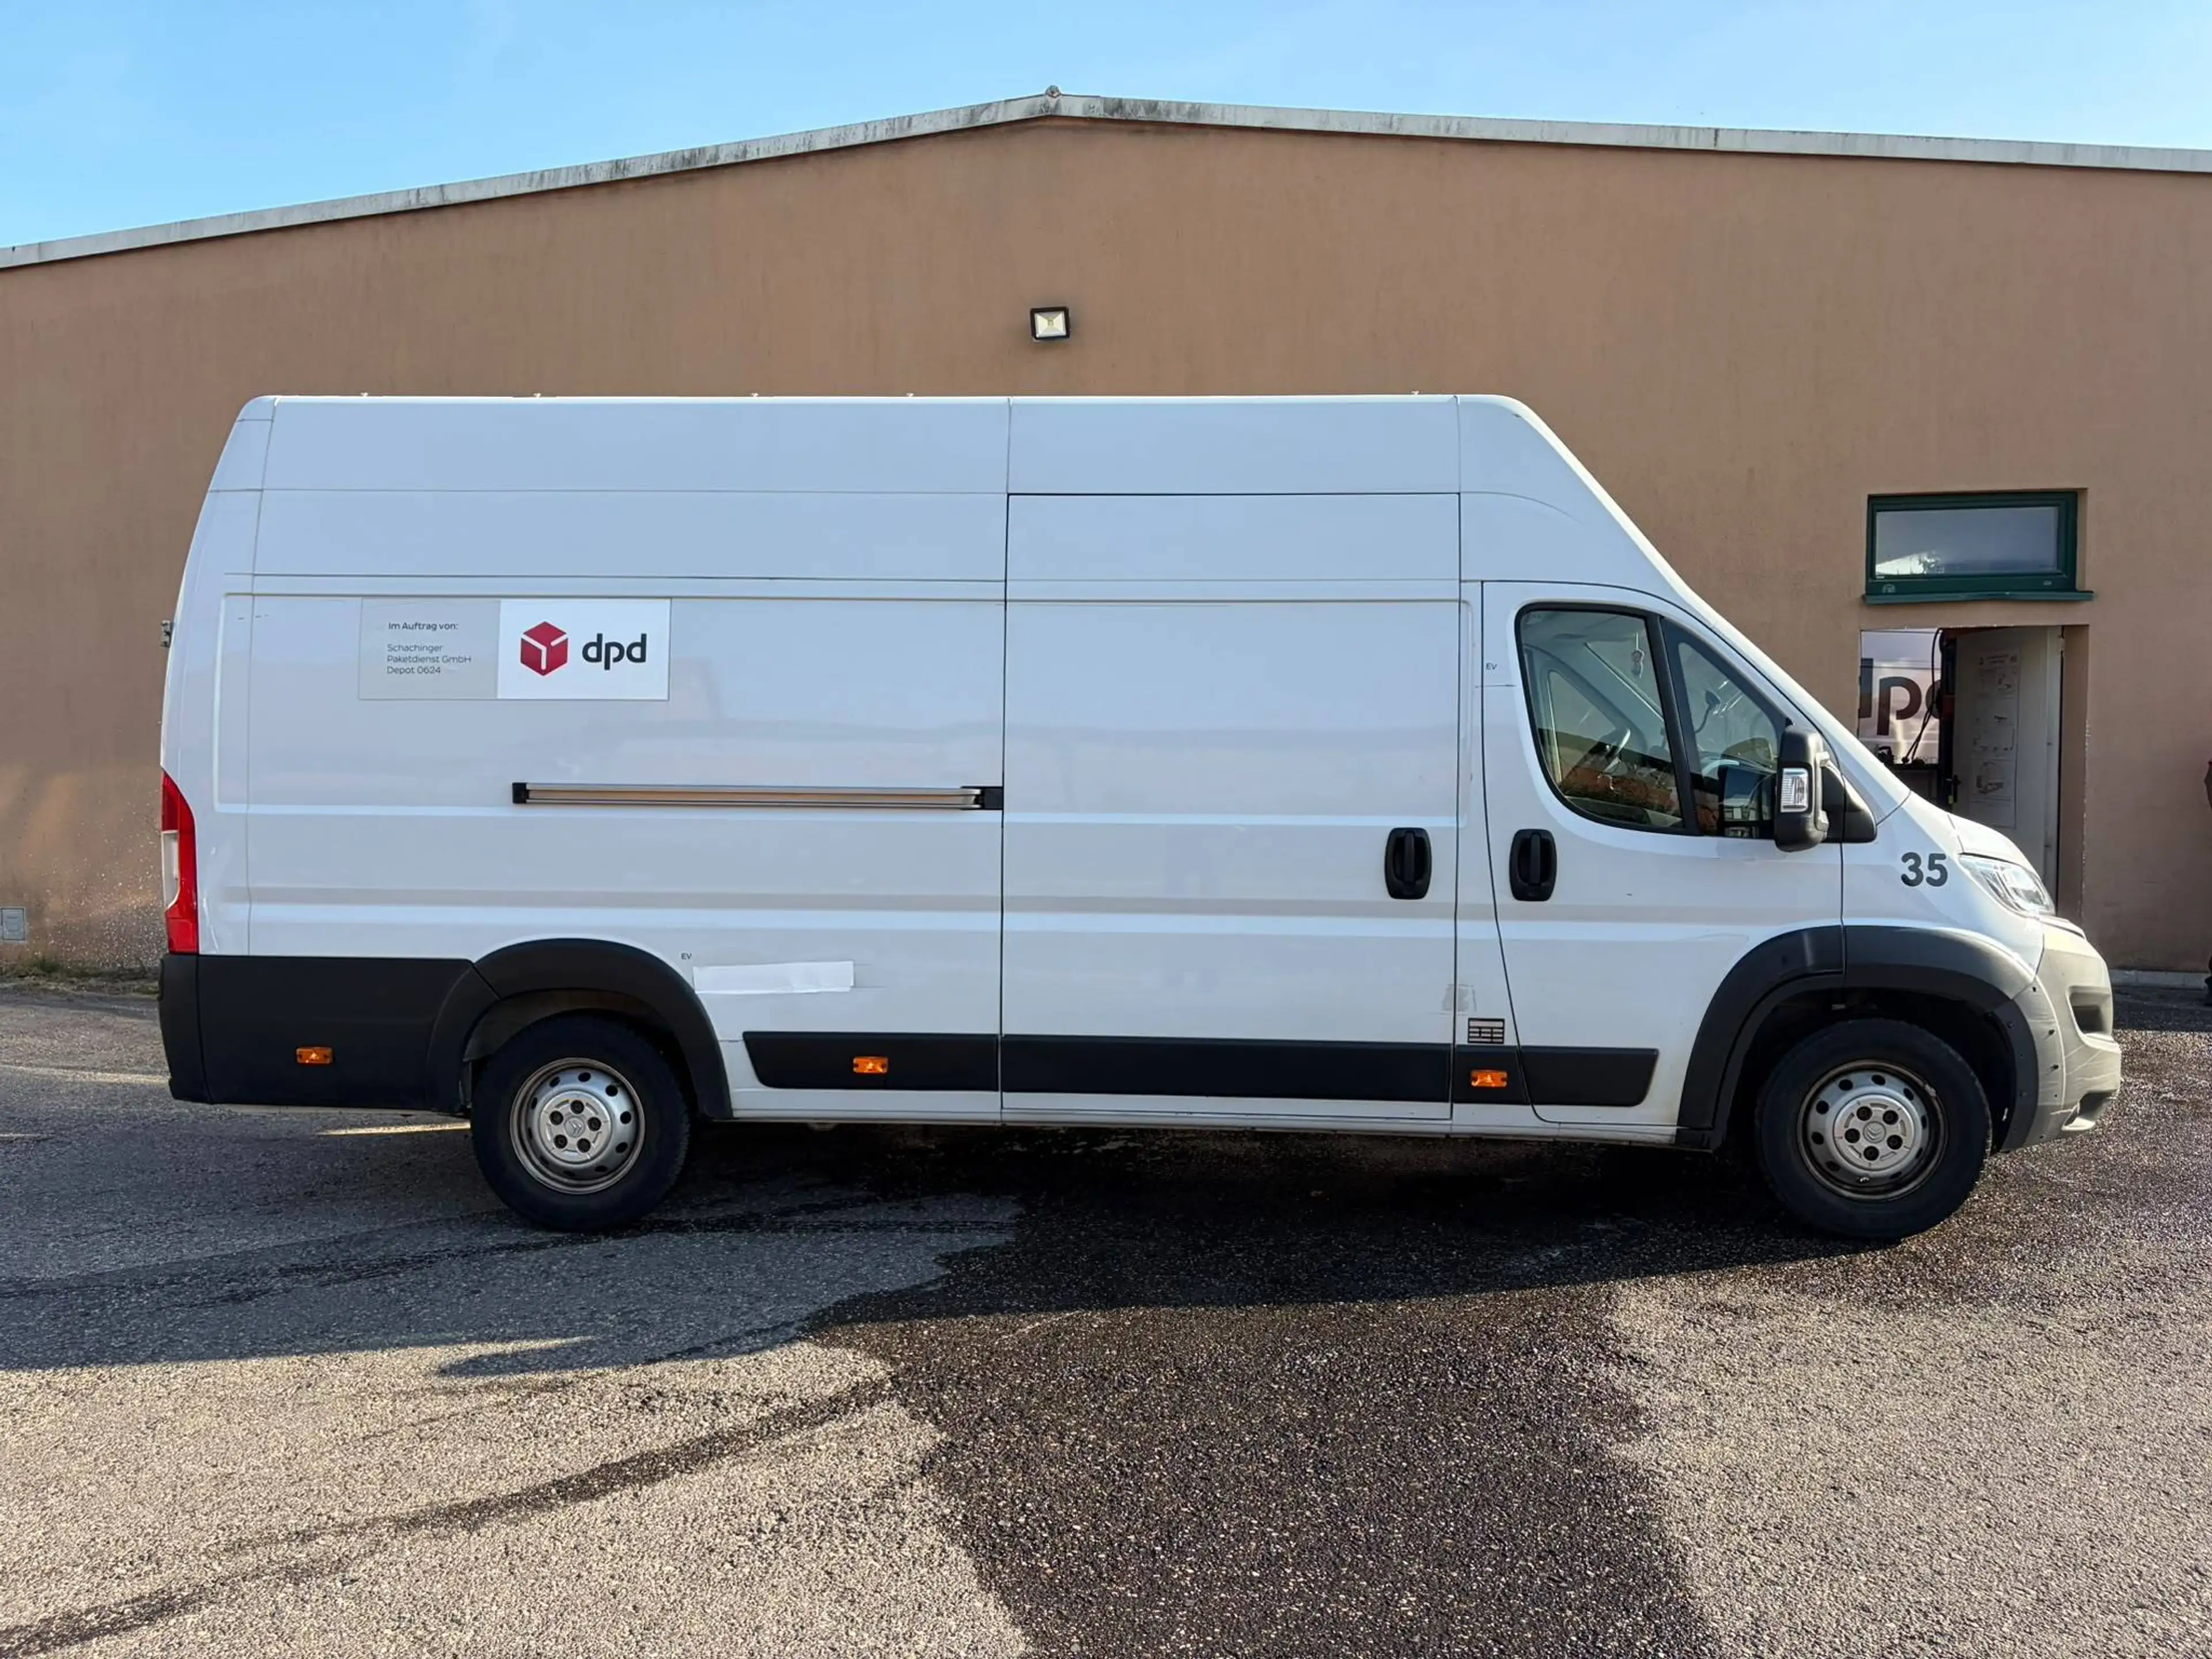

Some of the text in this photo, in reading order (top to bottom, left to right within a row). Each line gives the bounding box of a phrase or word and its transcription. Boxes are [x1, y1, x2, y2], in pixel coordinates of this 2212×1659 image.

[402, 622, 437, 631] Auftrag
[387, 643, 443, 654] Schachinger
[582, 632, 647, 671] dpd
[387, 655, 472, 663] Paketdienst GmbH
[387, 666, 441, 675] Depot 0624
[1901, 851, 1948, 888] 35
[681, 952, 692, 960] EV
